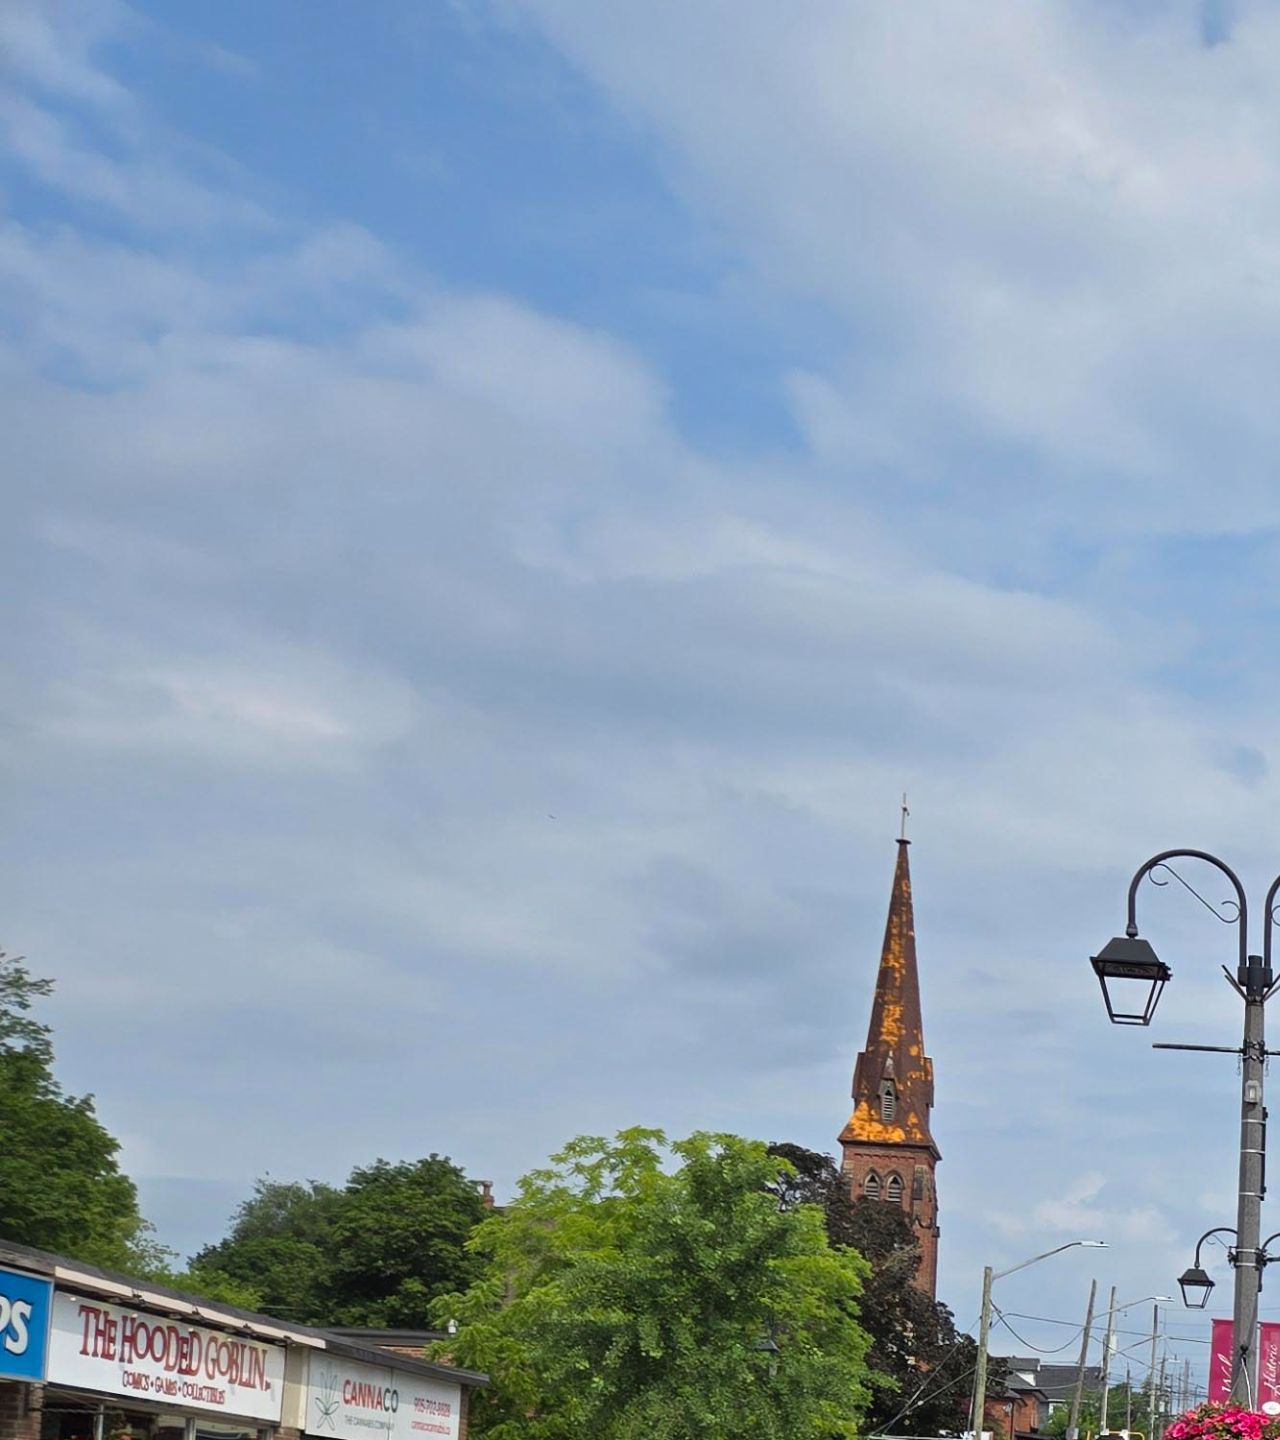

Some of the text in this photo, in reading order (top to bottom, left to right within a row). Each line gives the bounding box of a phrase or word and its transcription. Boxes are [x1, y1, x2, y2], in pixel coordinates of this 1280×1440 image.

[79, 1305, 117, 1361] THE
[119, 1315, 203, 1377] HOODED
[122, 1371, 226, 1404] COMICS GAMES COLLECTIBLES
[1263, 1344, 1278, 1391] Historic
[343, 1379, 399, 1413] CANNACO
